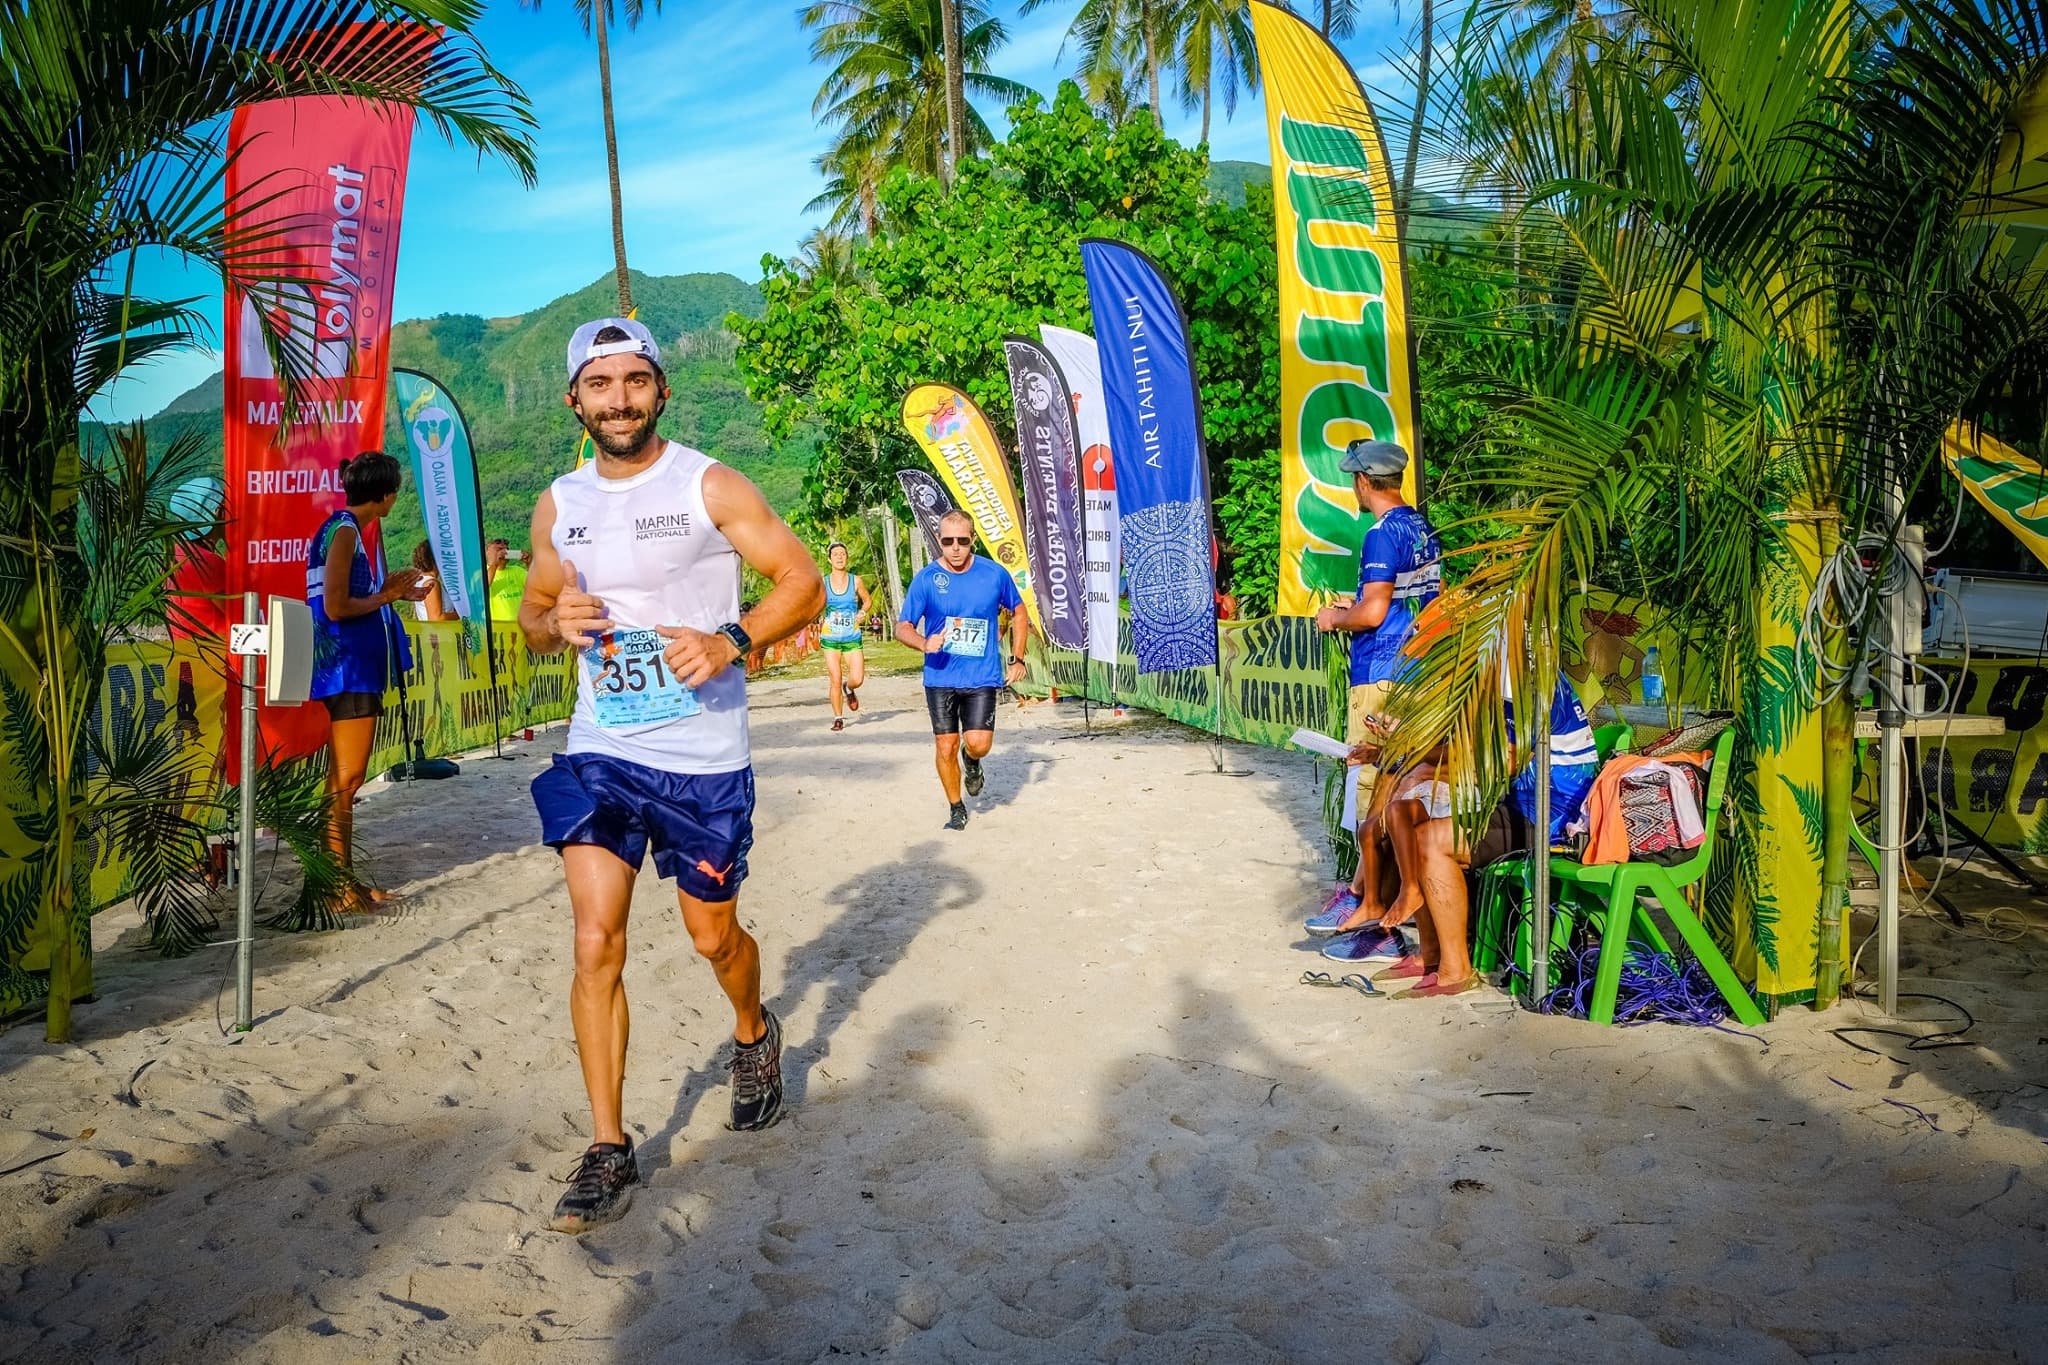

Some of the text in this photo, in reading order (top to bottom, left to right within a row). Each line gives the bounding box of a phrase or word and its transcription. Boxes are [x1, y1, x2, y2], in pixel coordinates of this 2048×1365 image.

[360, 199, 385, 350] MOOREA
[1125, 295, 1163, 469] AIR TAHITI NUI
[939, 443, 1005, 543] MARATHON
[635, 513, 691, 531] MARINE
[636, 529, 691, 541] NATIONALE
[951, 627, 981, 643] 317
[603, 653, 666, 694] 351
